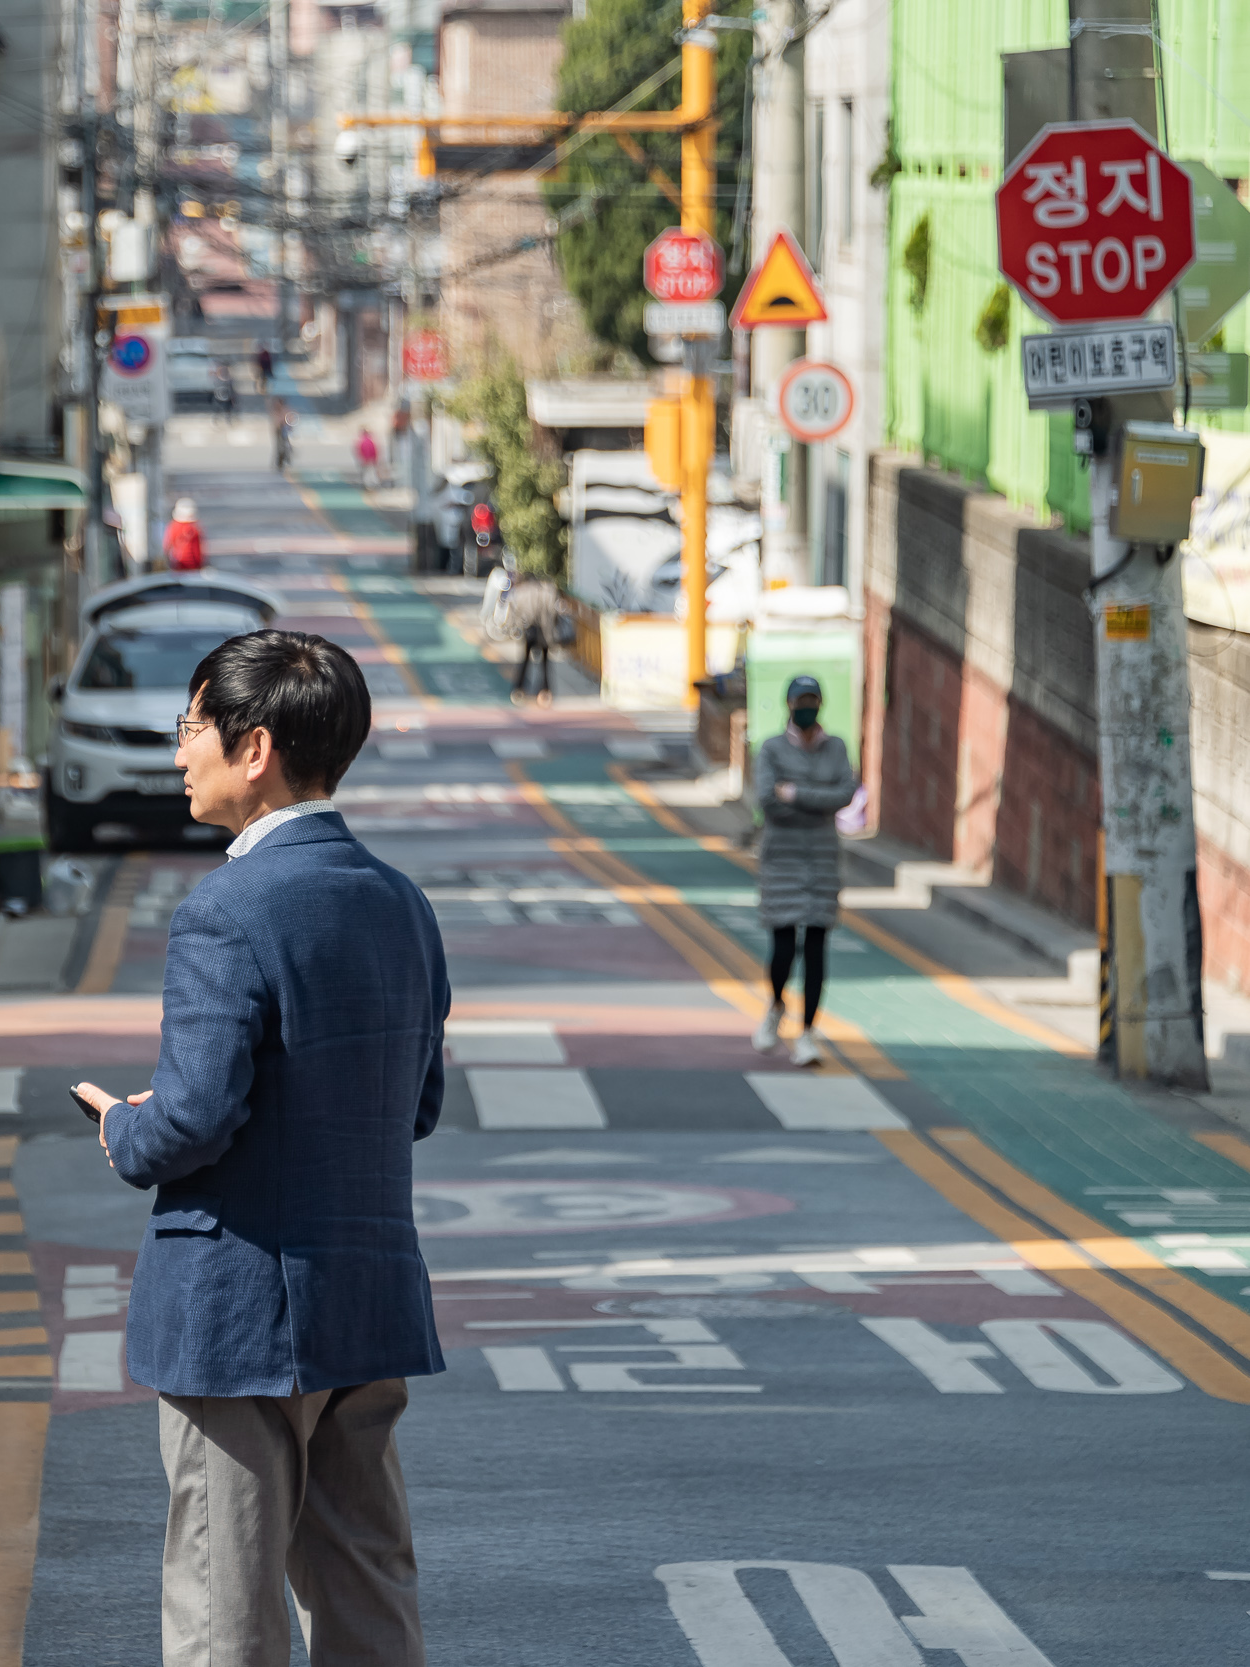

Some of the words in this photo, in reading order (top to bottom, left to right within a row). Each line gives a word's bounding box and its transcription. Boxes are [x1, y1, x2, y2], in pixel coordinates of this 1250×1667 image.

[1022, 151, 1164, 229] 정지
[1025, 235, 1167, 298] STOP
[1028, 334, 1170, 384] 어린이보호구역
[795, 377, 839, 422] 30
